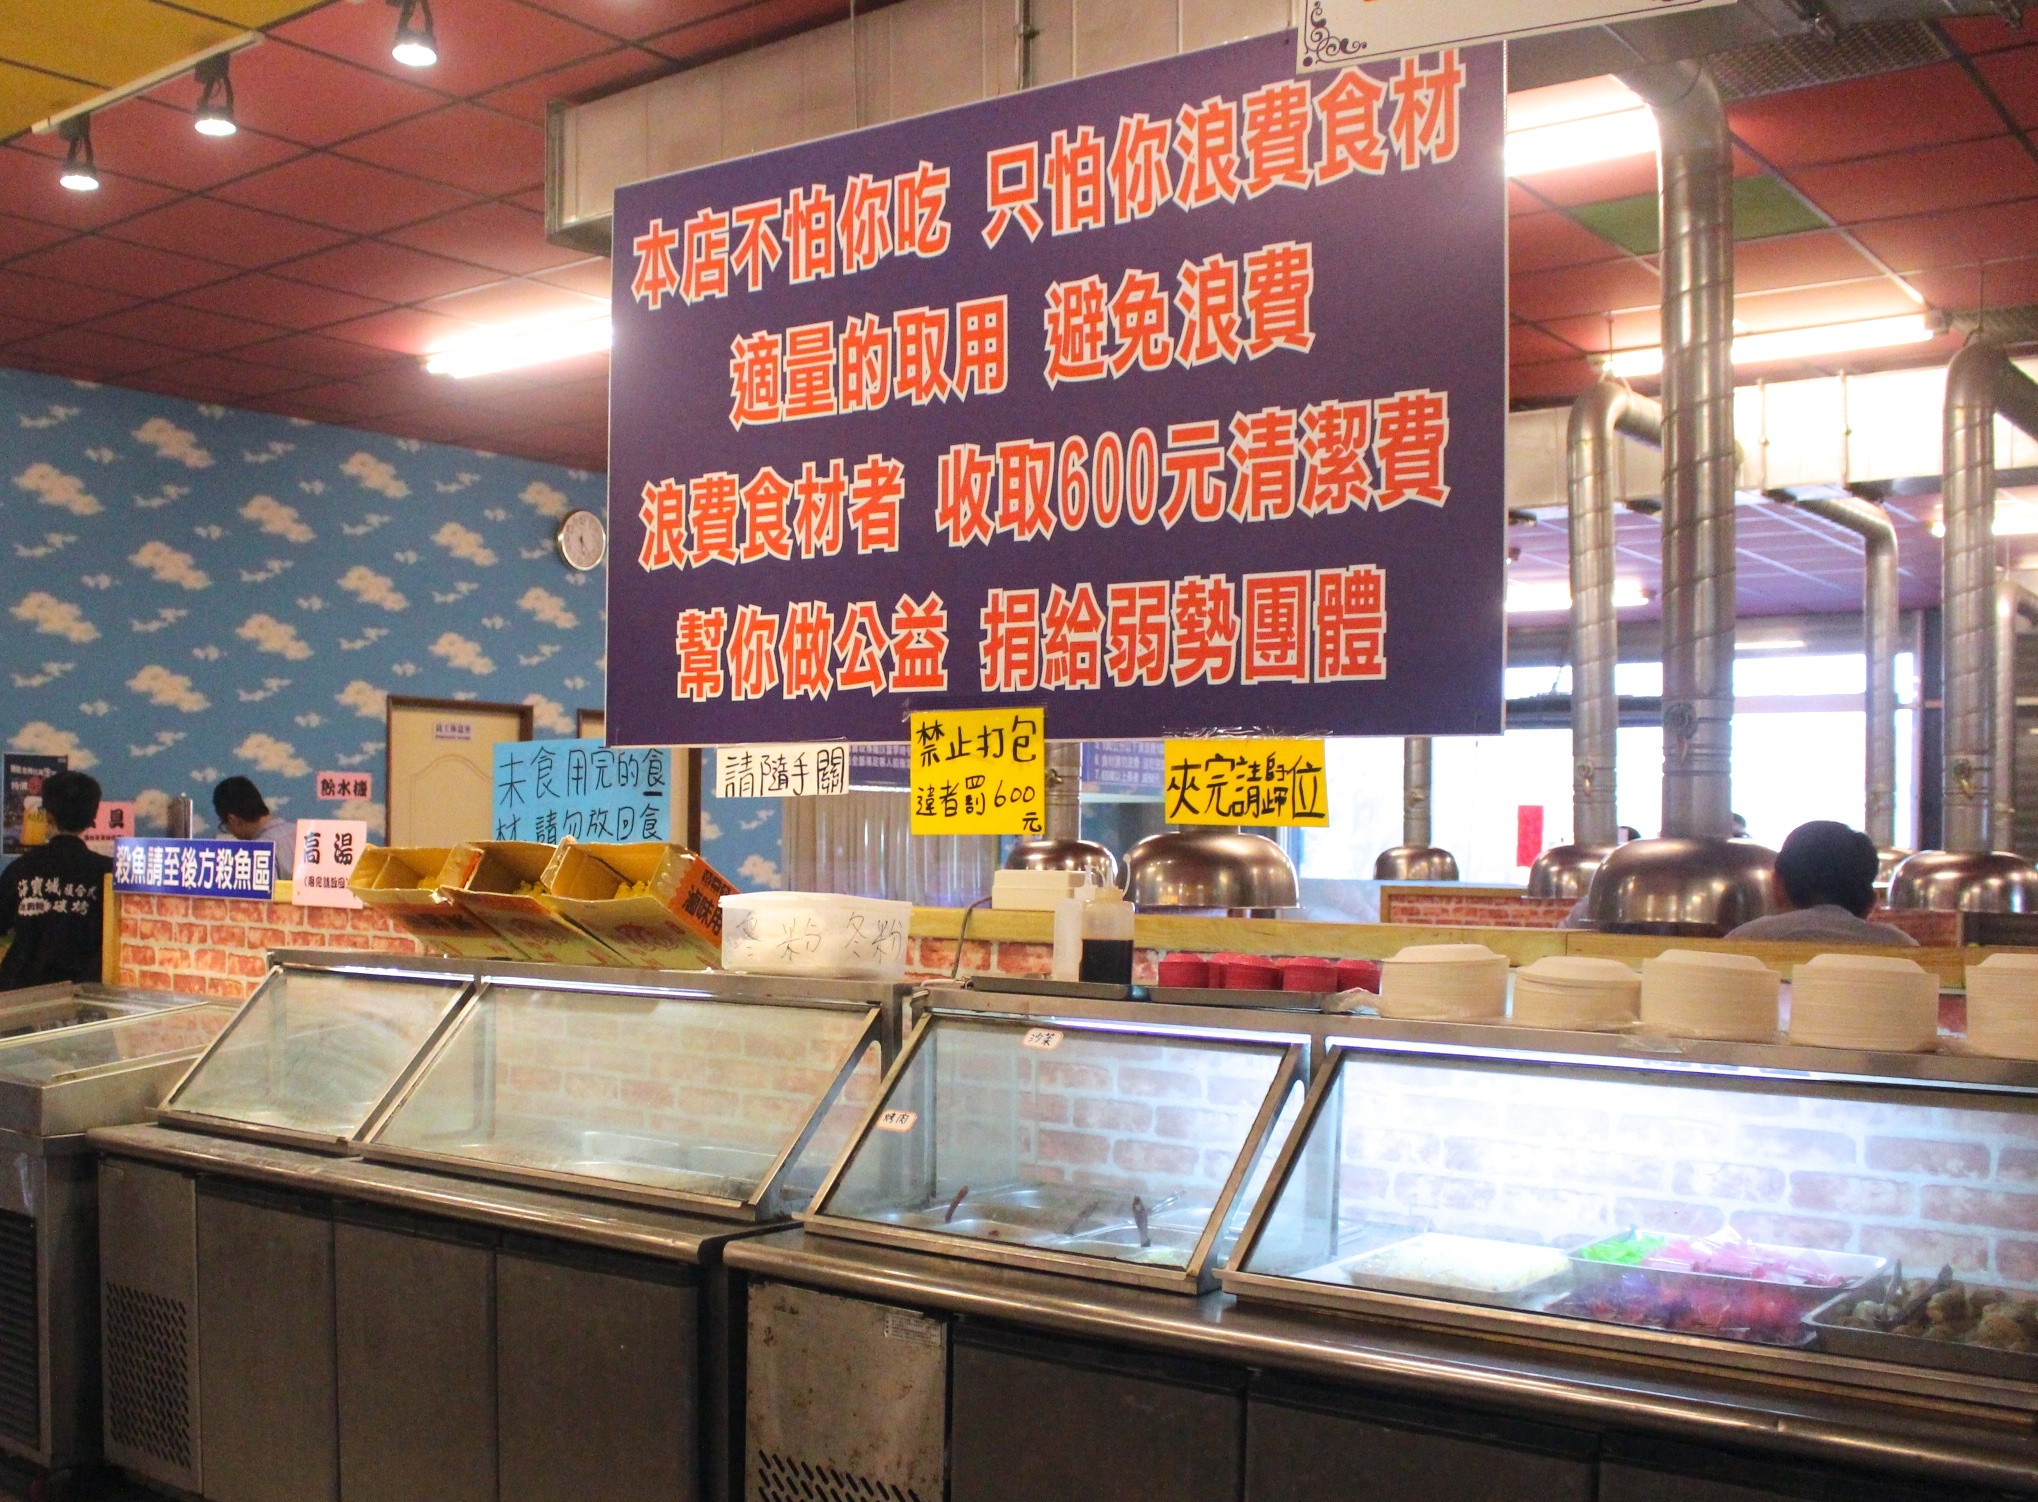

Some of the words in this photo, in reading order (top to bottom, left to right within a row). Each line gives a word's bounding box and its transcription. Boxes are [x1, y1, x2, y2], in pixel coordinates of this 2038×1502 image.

[631, 160, 950, 310] 本店不怕你吃
[982, 49, 1466, 248] 只怕你浪費食材
[729, 295, 1008, 431] 適量的取用
[1044, 241, 1315, 390] 避免浪費
[638, 454, 904, 571] 浪費食材者
[936, 388, 1451, 548] 收取600元清潔費
[676, 591, 949, 702] 幫你做公益
[980, 563, 1387, 693] 捐給弱勢團體
[916, 715, 1037, 766] 禁止打包
[498, 746, 666, 808] 未食用完的食
[725, 746, 845, 798] 請隨手關
[1168, 752, 1326, 819] 夾完請歸位
[303, 831, 354, 866] 高湯
[1022, 812, 1042, 833] 元
[115, 845, 272, 891] 殺魚請至後方殺魚區
[883, 1111, 910, 1125] 烤肉
